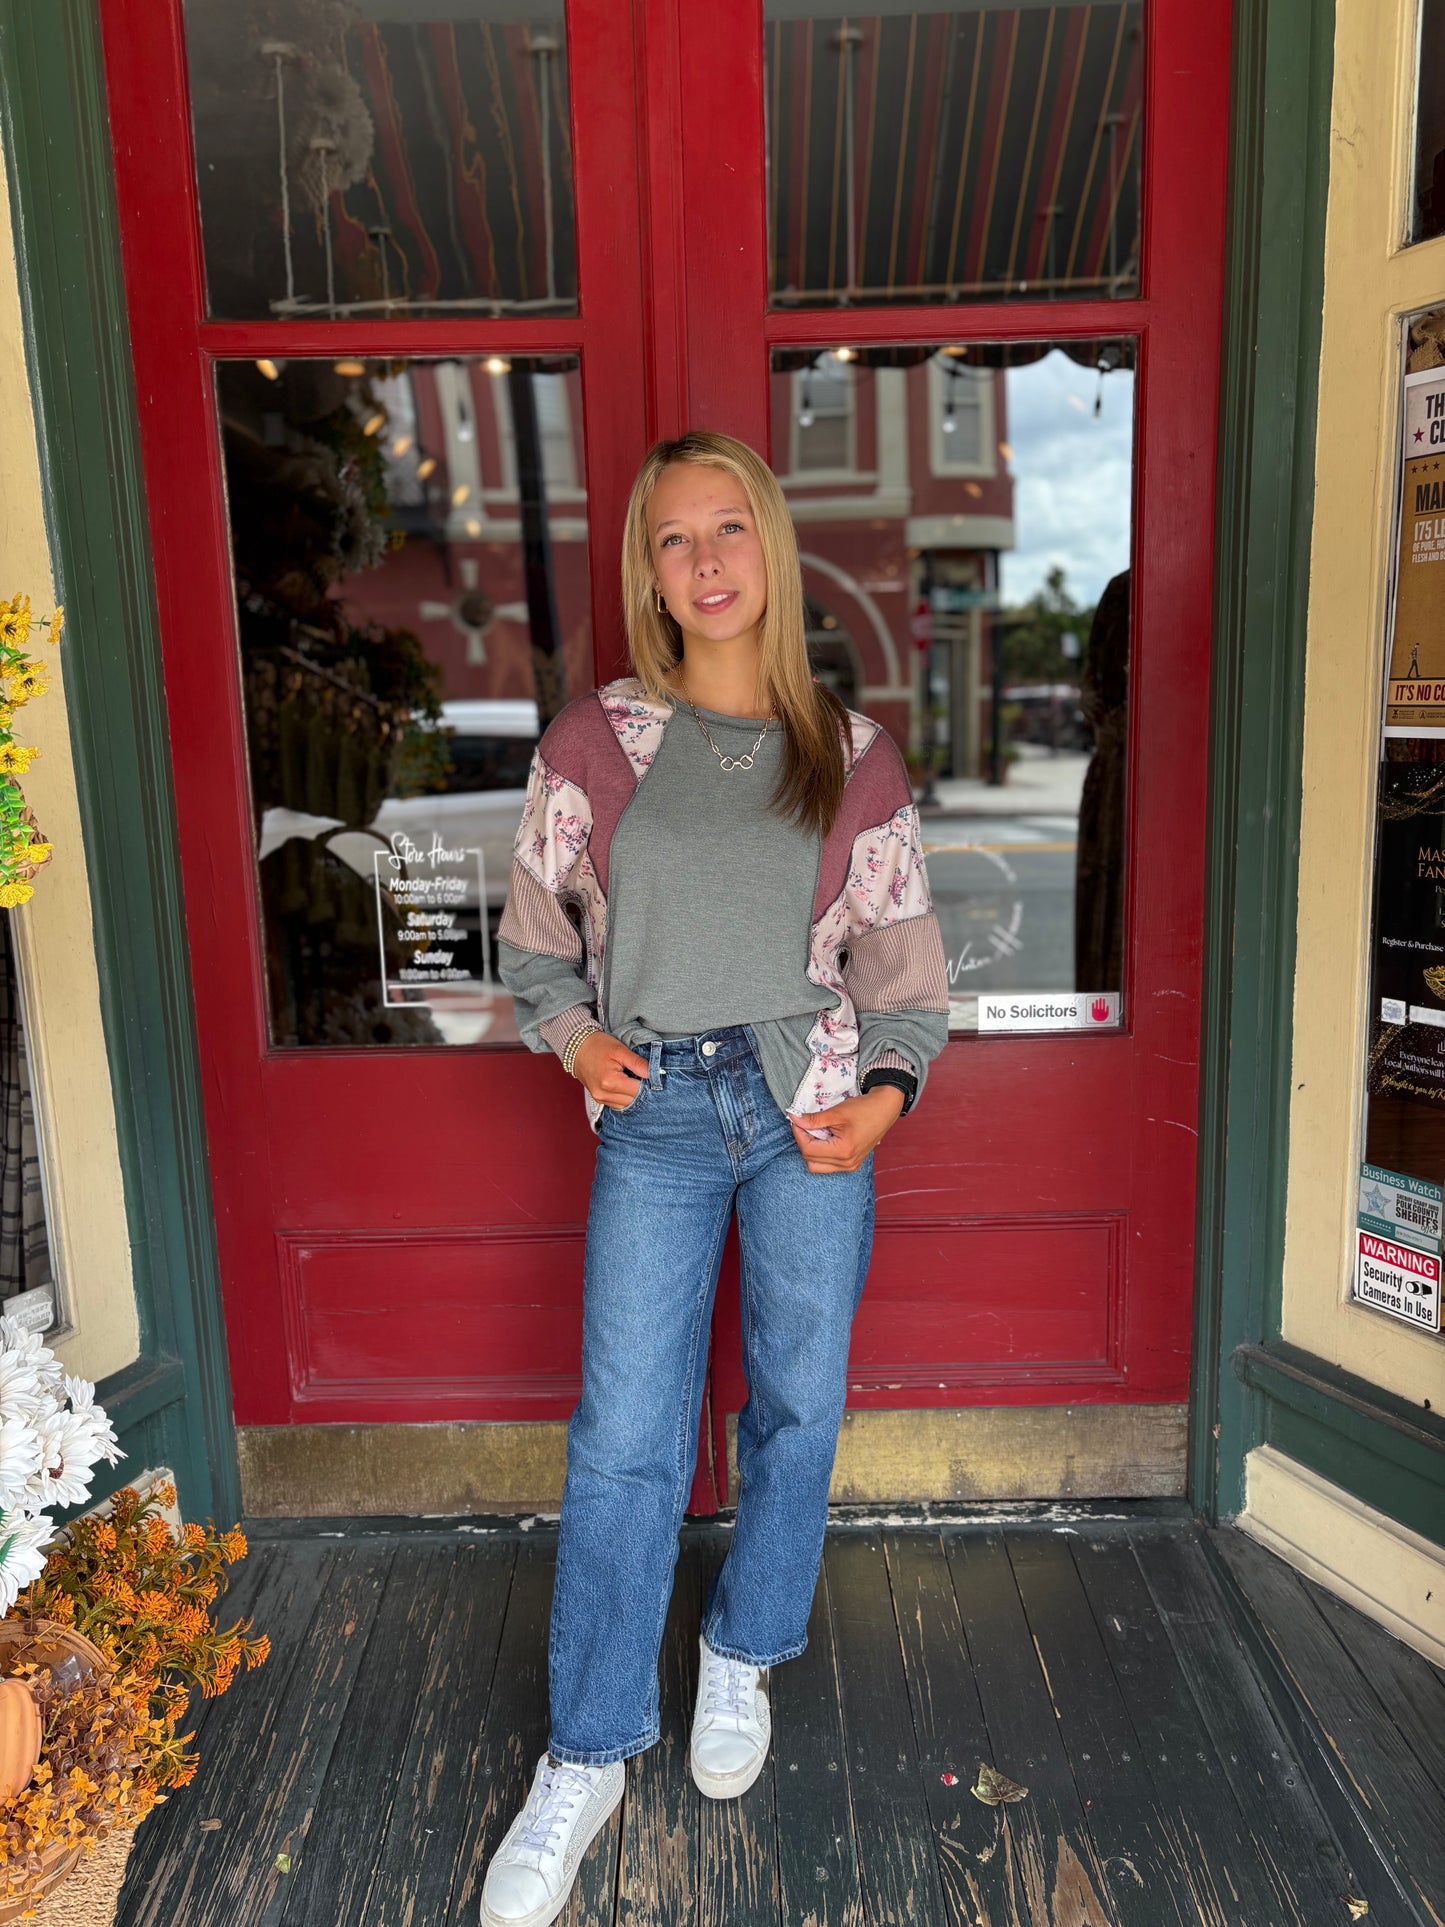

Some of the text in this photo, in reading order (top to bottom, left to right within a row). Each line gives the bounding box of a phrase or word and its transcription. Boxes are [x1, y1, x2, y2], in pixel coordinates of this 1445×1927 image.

[1414, 520, 1432, 541] 175
[1412, 554, 1428, 563] FLESH
[1428, 552, 1439, 561] AND
[1395, 684, 1415, 701] IT'S
[1416, 684, 1432, 701] NO
[388, 830, 465, 870] Store Hours
[389, 876, 468, 893] Monday-Friday
[427, 893, 436, 905] to
[407, 910, 457, 928] Saturday
[397, 929, 427, 941] 9:00am
[428, 930, 436, 940] to
[1382, 936, 1407, 948] Register
[1415, 941, 1444, 952] Purchase
[413, 949, 454, 966] Sunday
[987, 1004, 1077, 1019] No Solicitors
[1400, 1051, 1430, 1064] Everyone
[1385, 1058, 1402, 1068] Local
[1430, 1069, 1440, 1078] will
[1362, 1165, 1441, 1200] Business Watch
[1396, 1199, 1438, 1219] POLK COUNTY
[1395, 1206, 1438, 1231] SHERIFF'S
[1363, 1237, 1435, 1276] WARNING
[1364, 1261, 1402, 1292] Security
[1364, 1280, 1433, 1321] Cameras In Use
